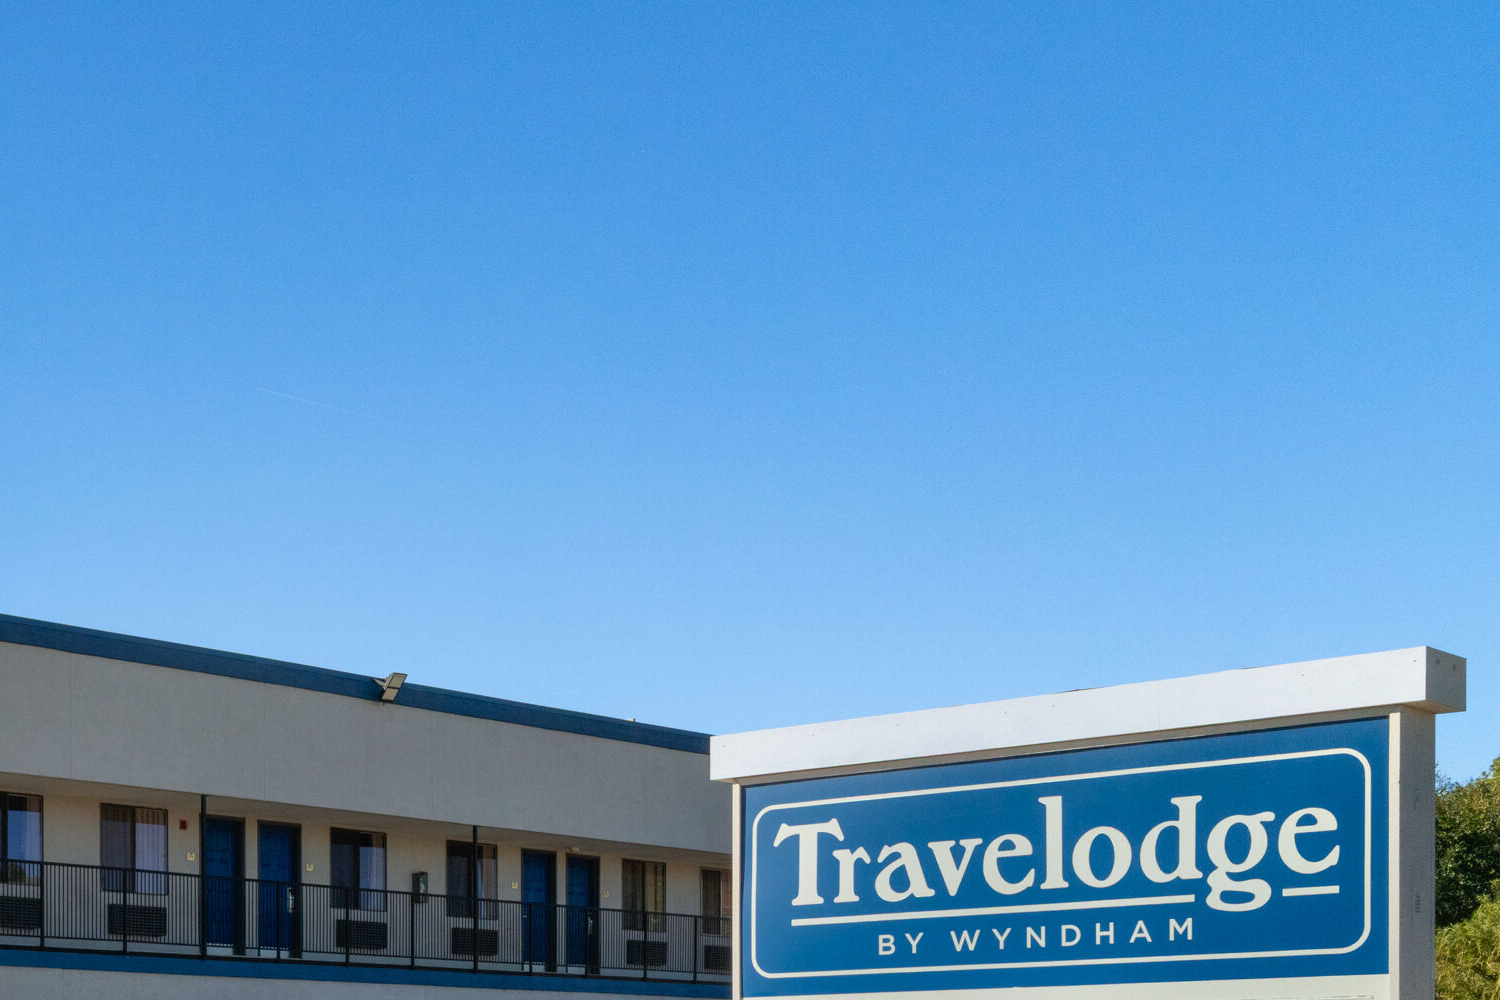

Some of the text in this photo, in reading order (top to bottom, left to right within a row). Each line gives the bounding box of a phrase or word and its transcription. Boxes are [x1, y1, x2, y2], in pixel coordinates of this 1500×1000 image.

[773, 795, 1341, 912] Travelodge
[878, 917, 1194, 956] BY WYNDHAM
